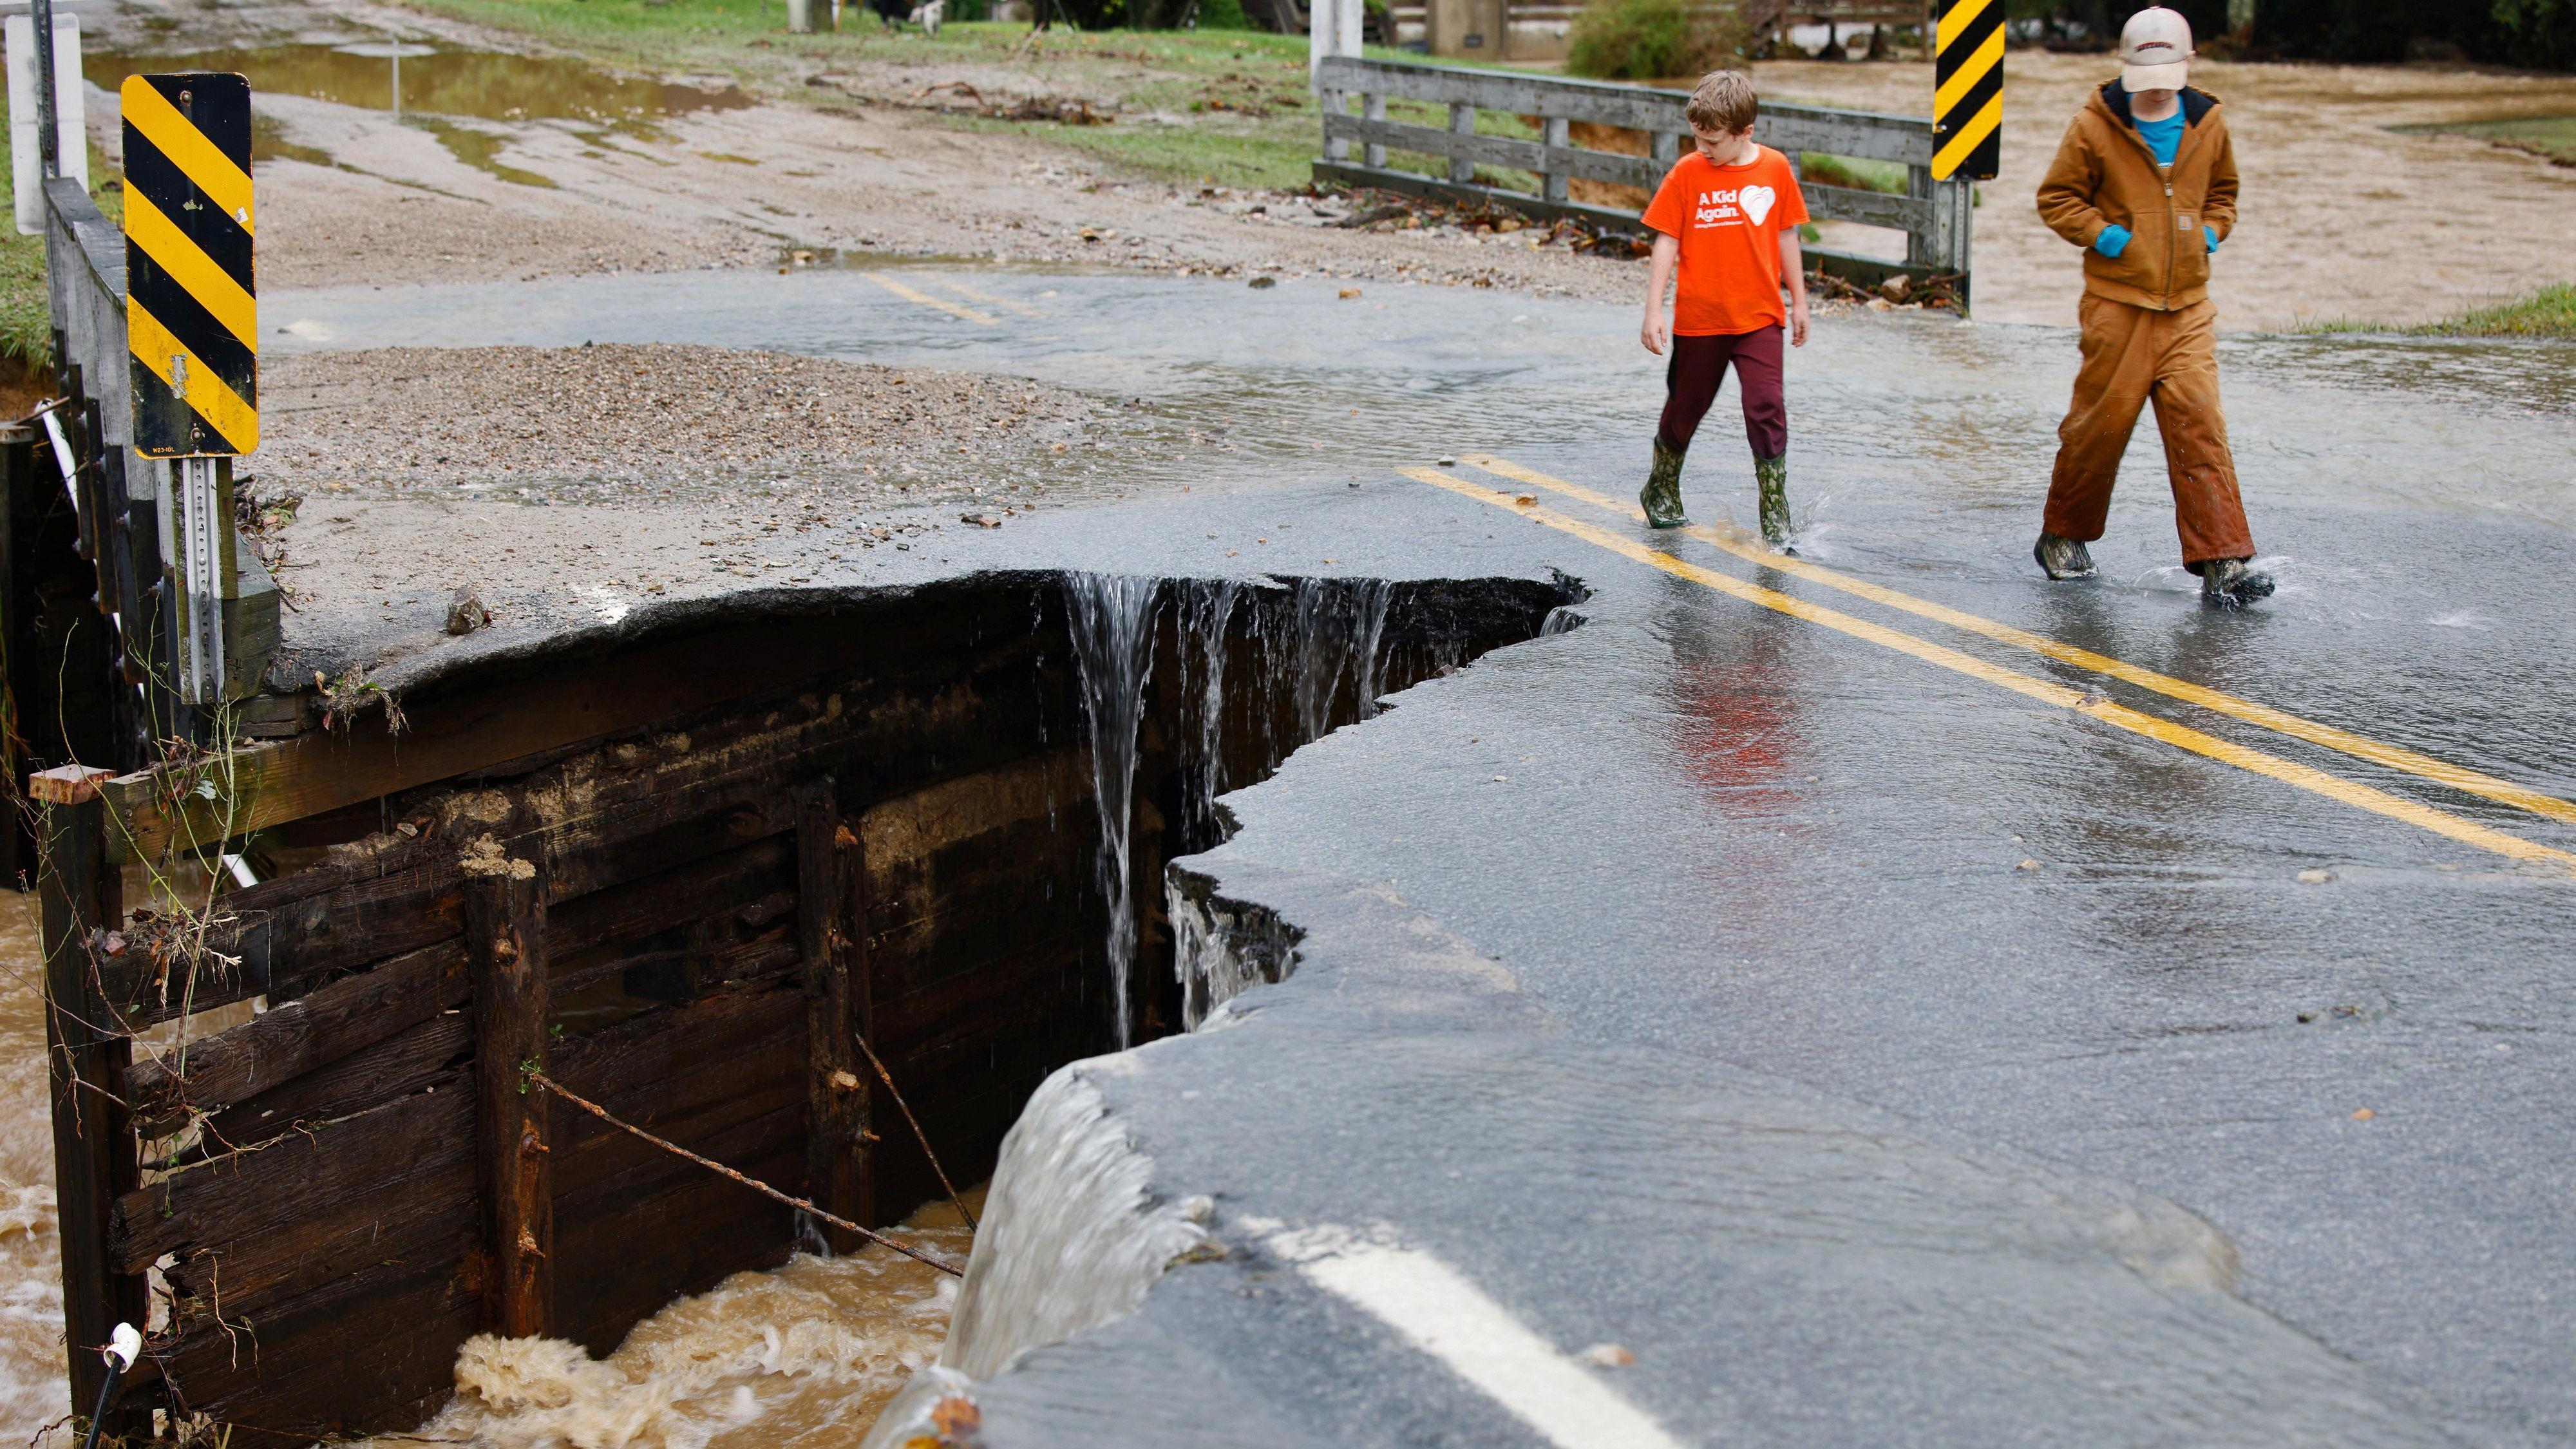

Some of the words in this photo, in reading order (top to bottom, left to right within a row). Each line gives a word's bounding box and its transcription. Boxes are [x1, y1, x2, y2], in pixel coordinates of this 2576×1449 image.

[1699, 193, 1710, 205] A
[1712, 189, 1737, 204] Kid
[1695, 204, 1739, 222] Again.
